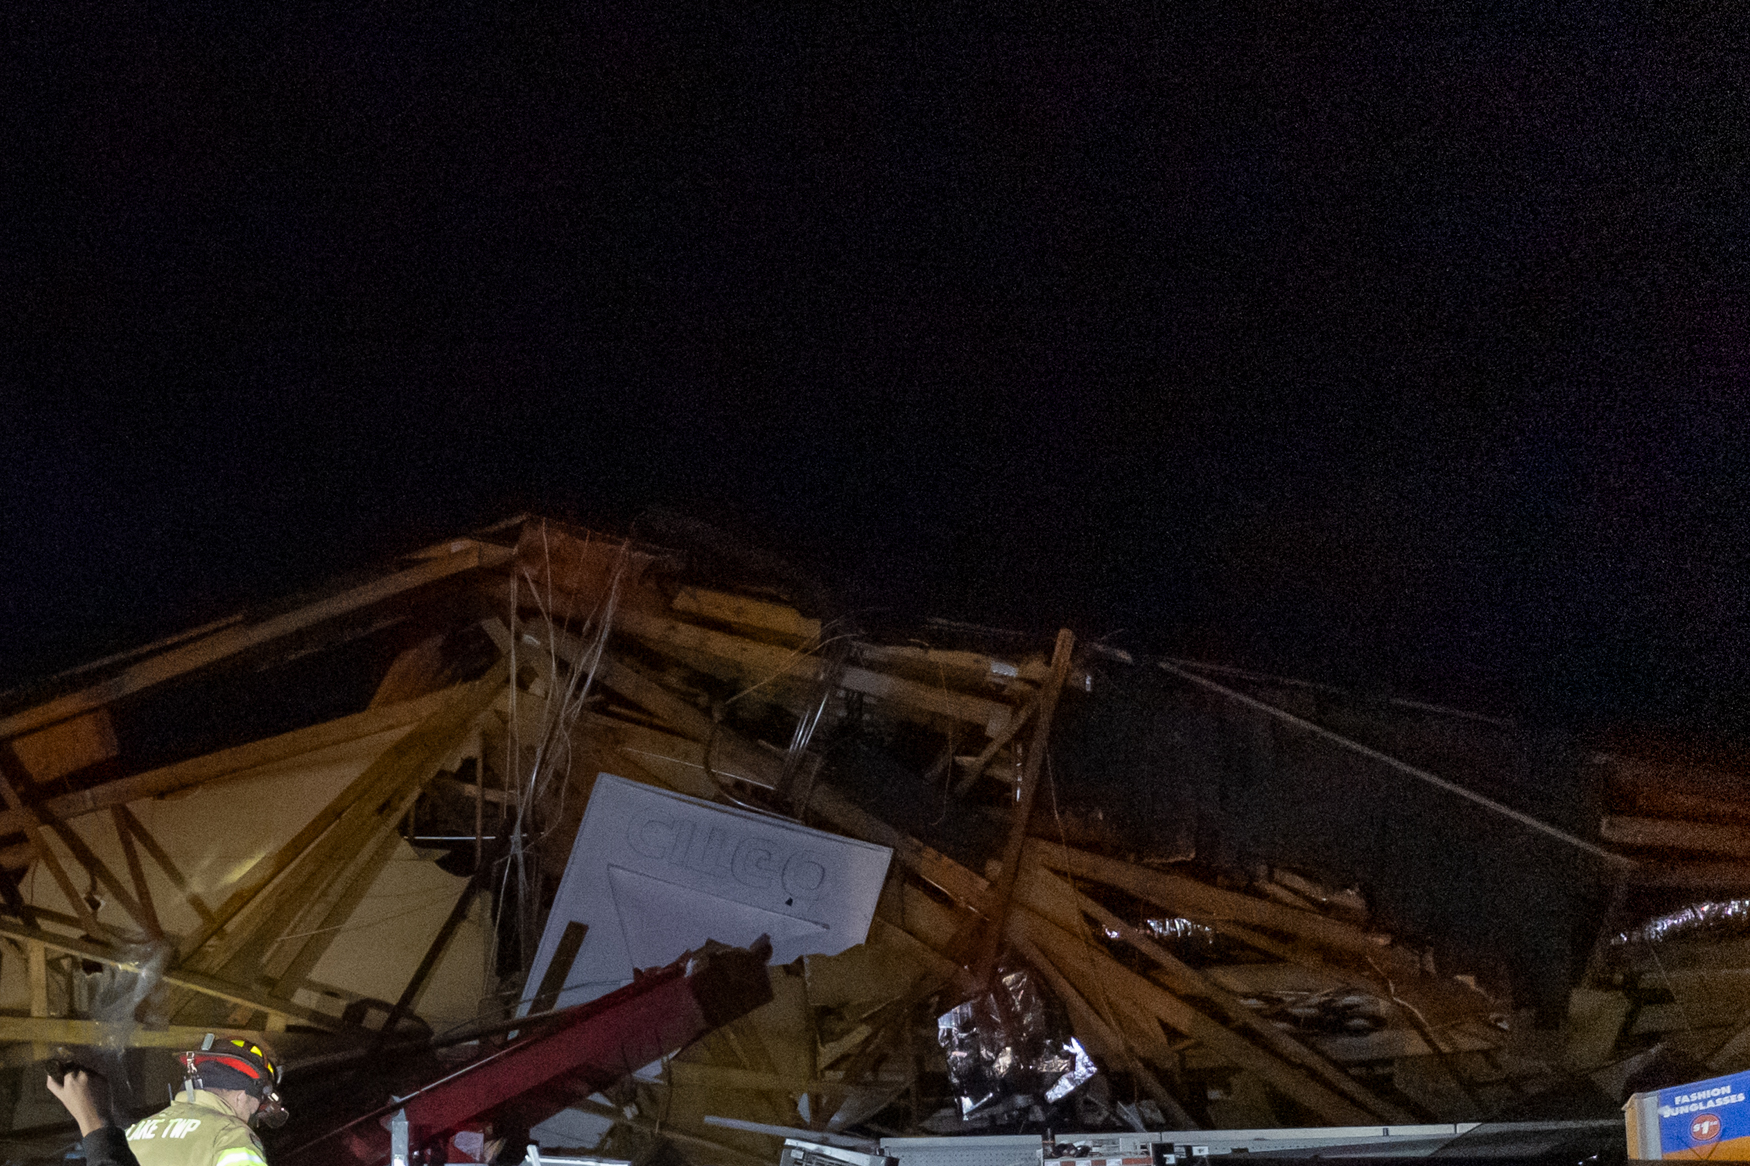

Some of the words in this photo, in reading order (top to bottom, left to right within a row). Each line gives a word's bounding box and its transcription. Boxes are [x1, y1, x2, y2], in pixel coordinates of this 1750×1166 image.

[1662, 1092, 1746, 1118] SUNGLASSES
[1674, 1085, 1732, 1105] FASHION
[125, 1118, 165, 1142] LAKE
[161, 1117, 201, 1139] TWP
